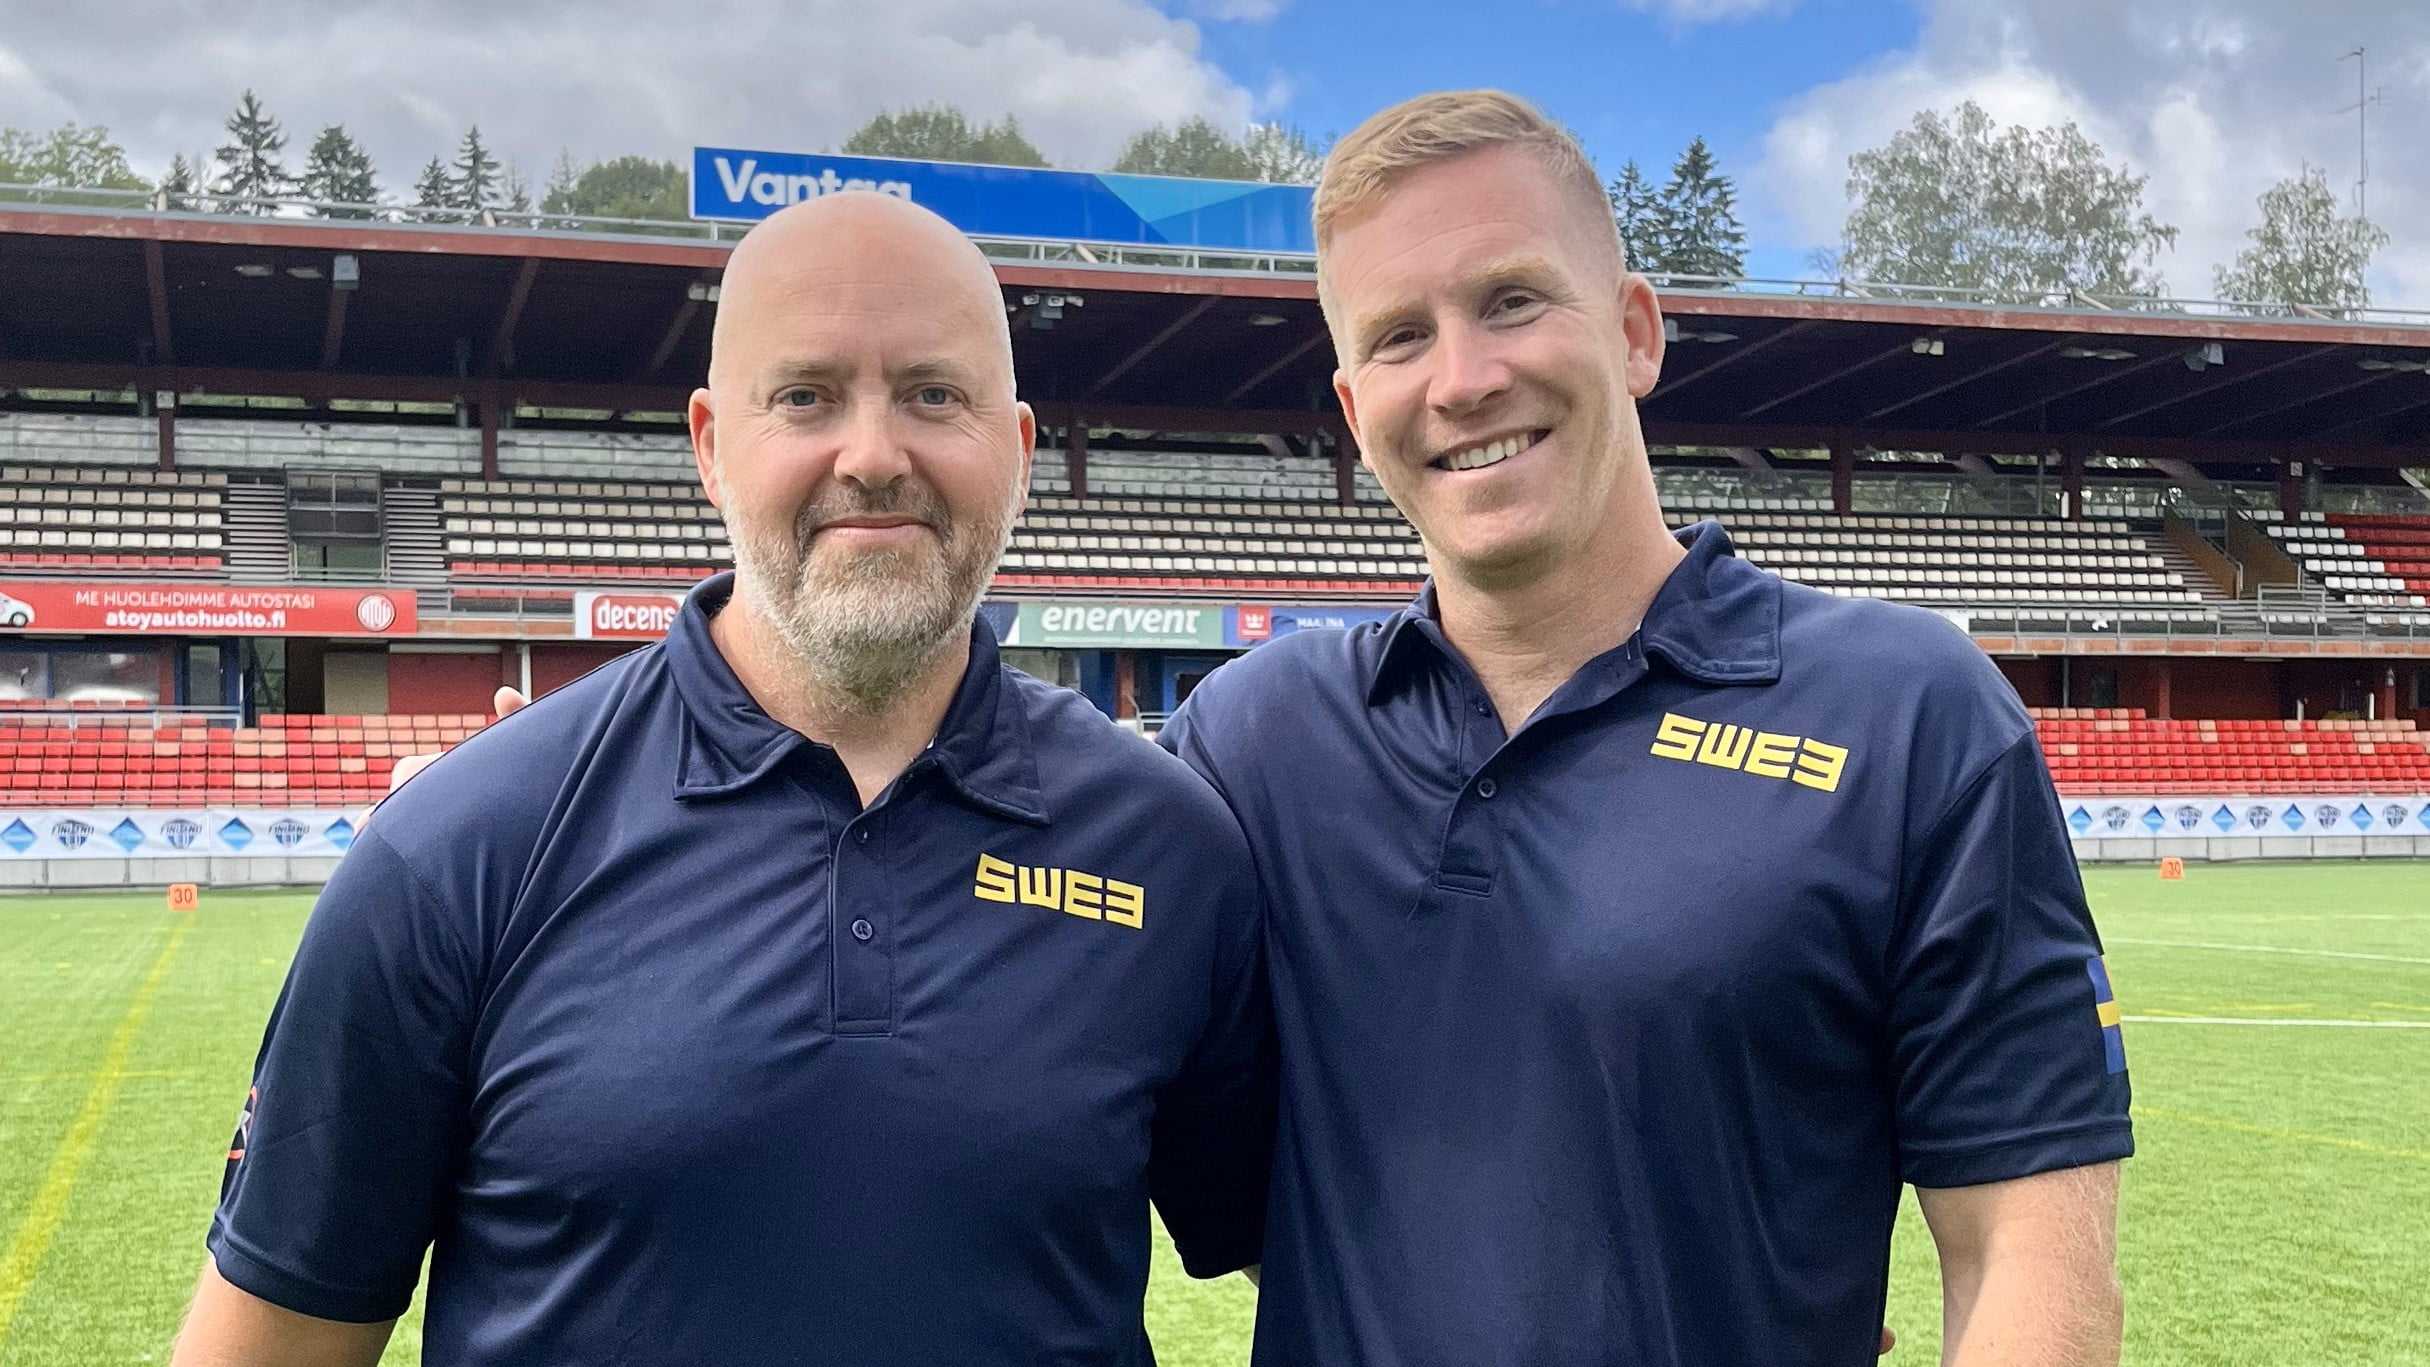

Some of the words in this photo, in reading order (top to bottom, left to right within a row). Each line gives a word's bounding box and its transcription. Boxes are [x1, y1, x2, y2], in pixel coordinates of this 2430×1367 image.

[75, 591, 99, 606] ME
[103, 591, 225, 608] HUOLEHDIMME
[229, 592, 315, 609] AUTOSTASI
[105, 609, 286, 630] atoyautohuolto.fi
[1041, 606, 1201, 634] enervent
[174, 888, 193, 904] 30
